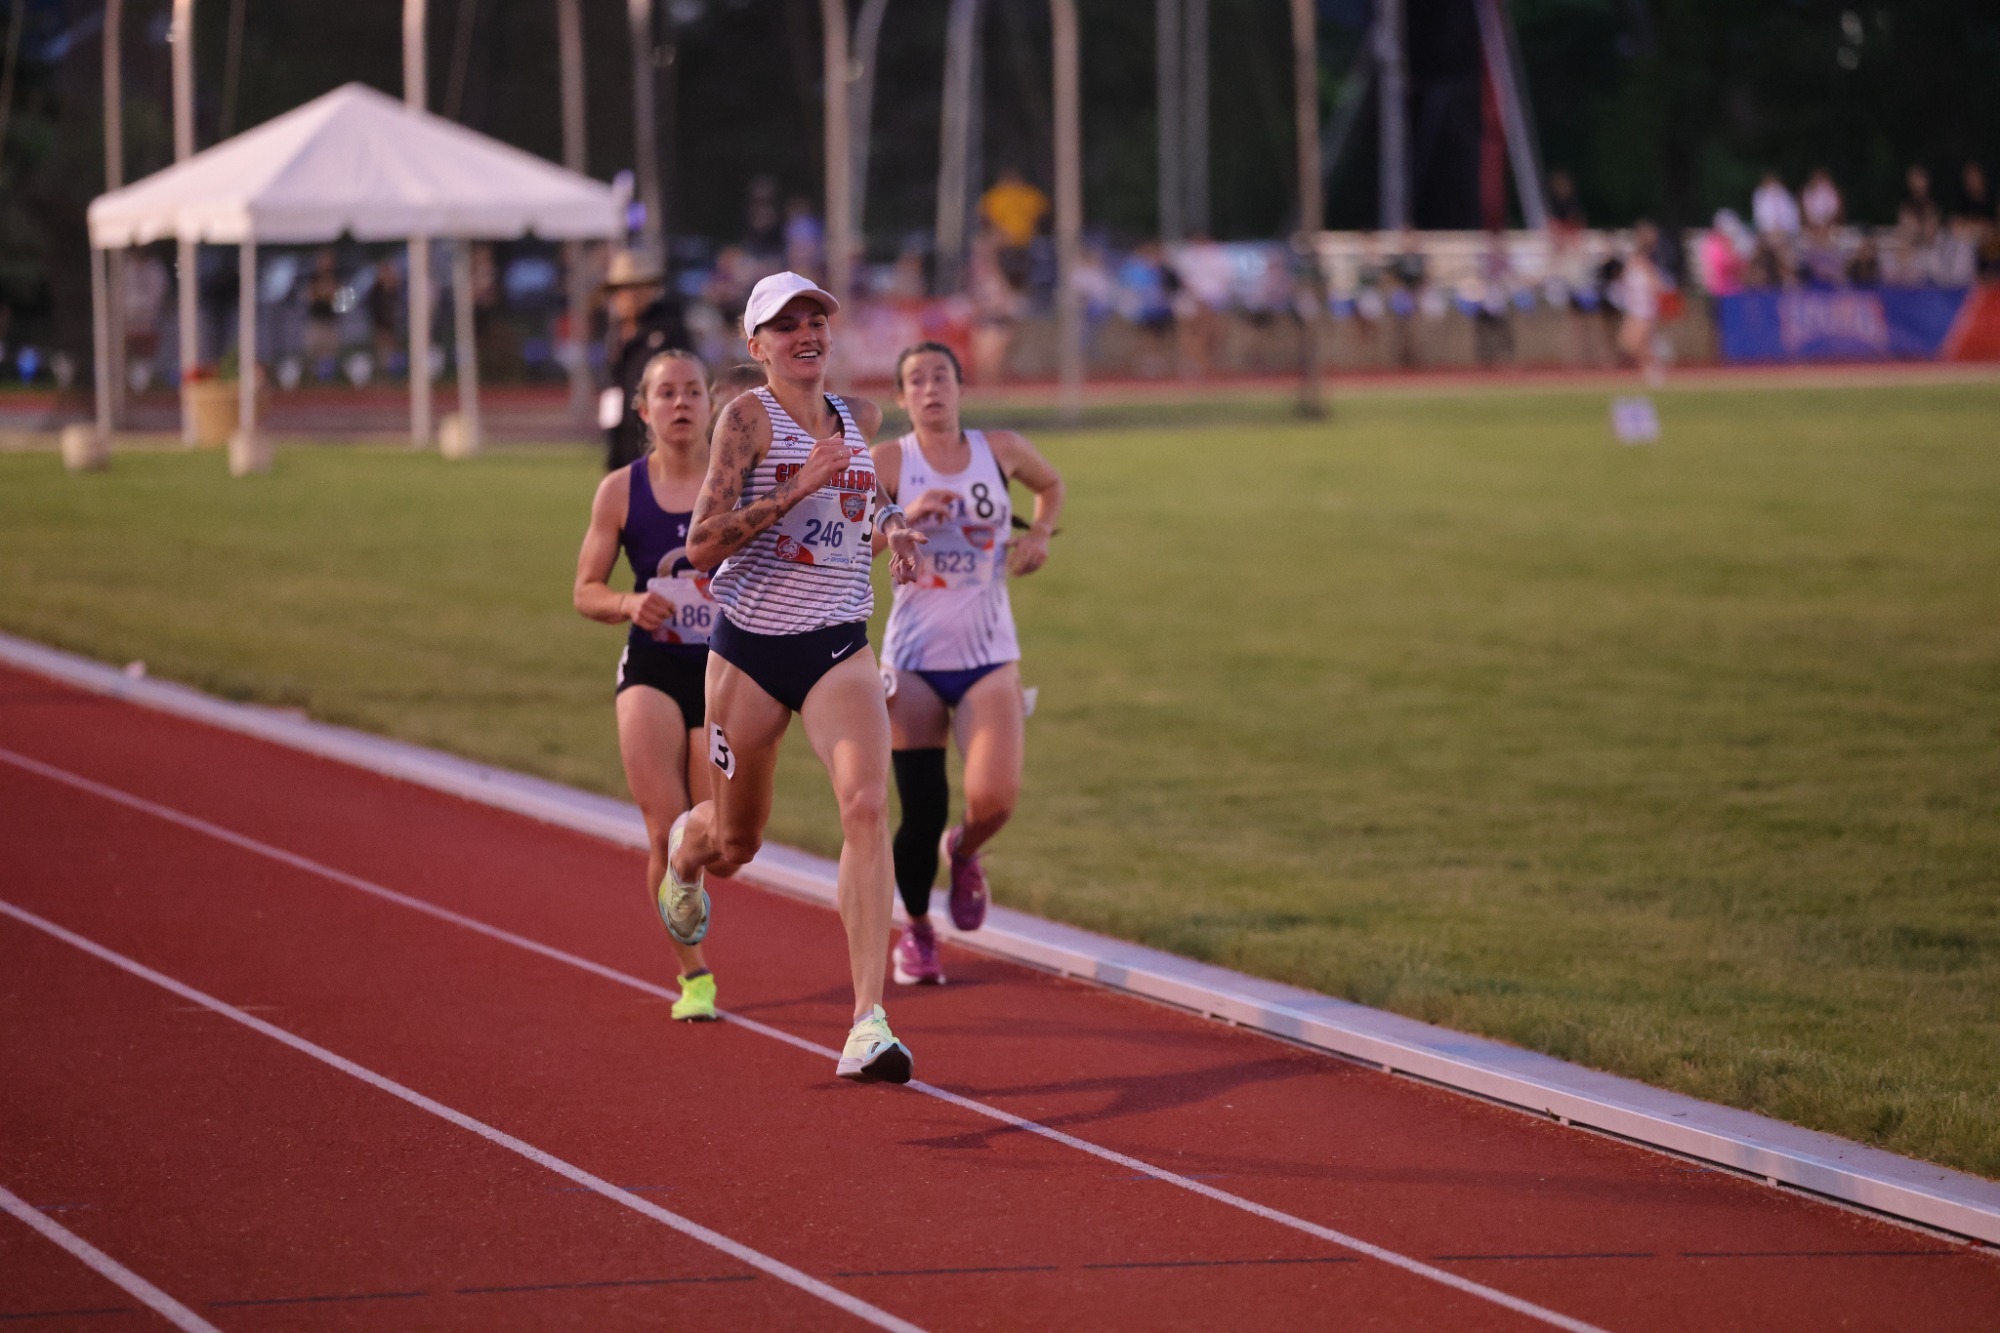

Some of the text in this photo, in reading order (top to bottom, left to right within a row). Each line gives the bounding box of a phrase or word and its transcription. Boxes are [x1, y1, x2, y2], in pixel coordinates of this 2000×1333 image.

[971, 482, 994, 518] 8
[802, 518, 845, 548] 246
[933, 551, 977, 573] 623
[671, 604, 711, 628] 186
